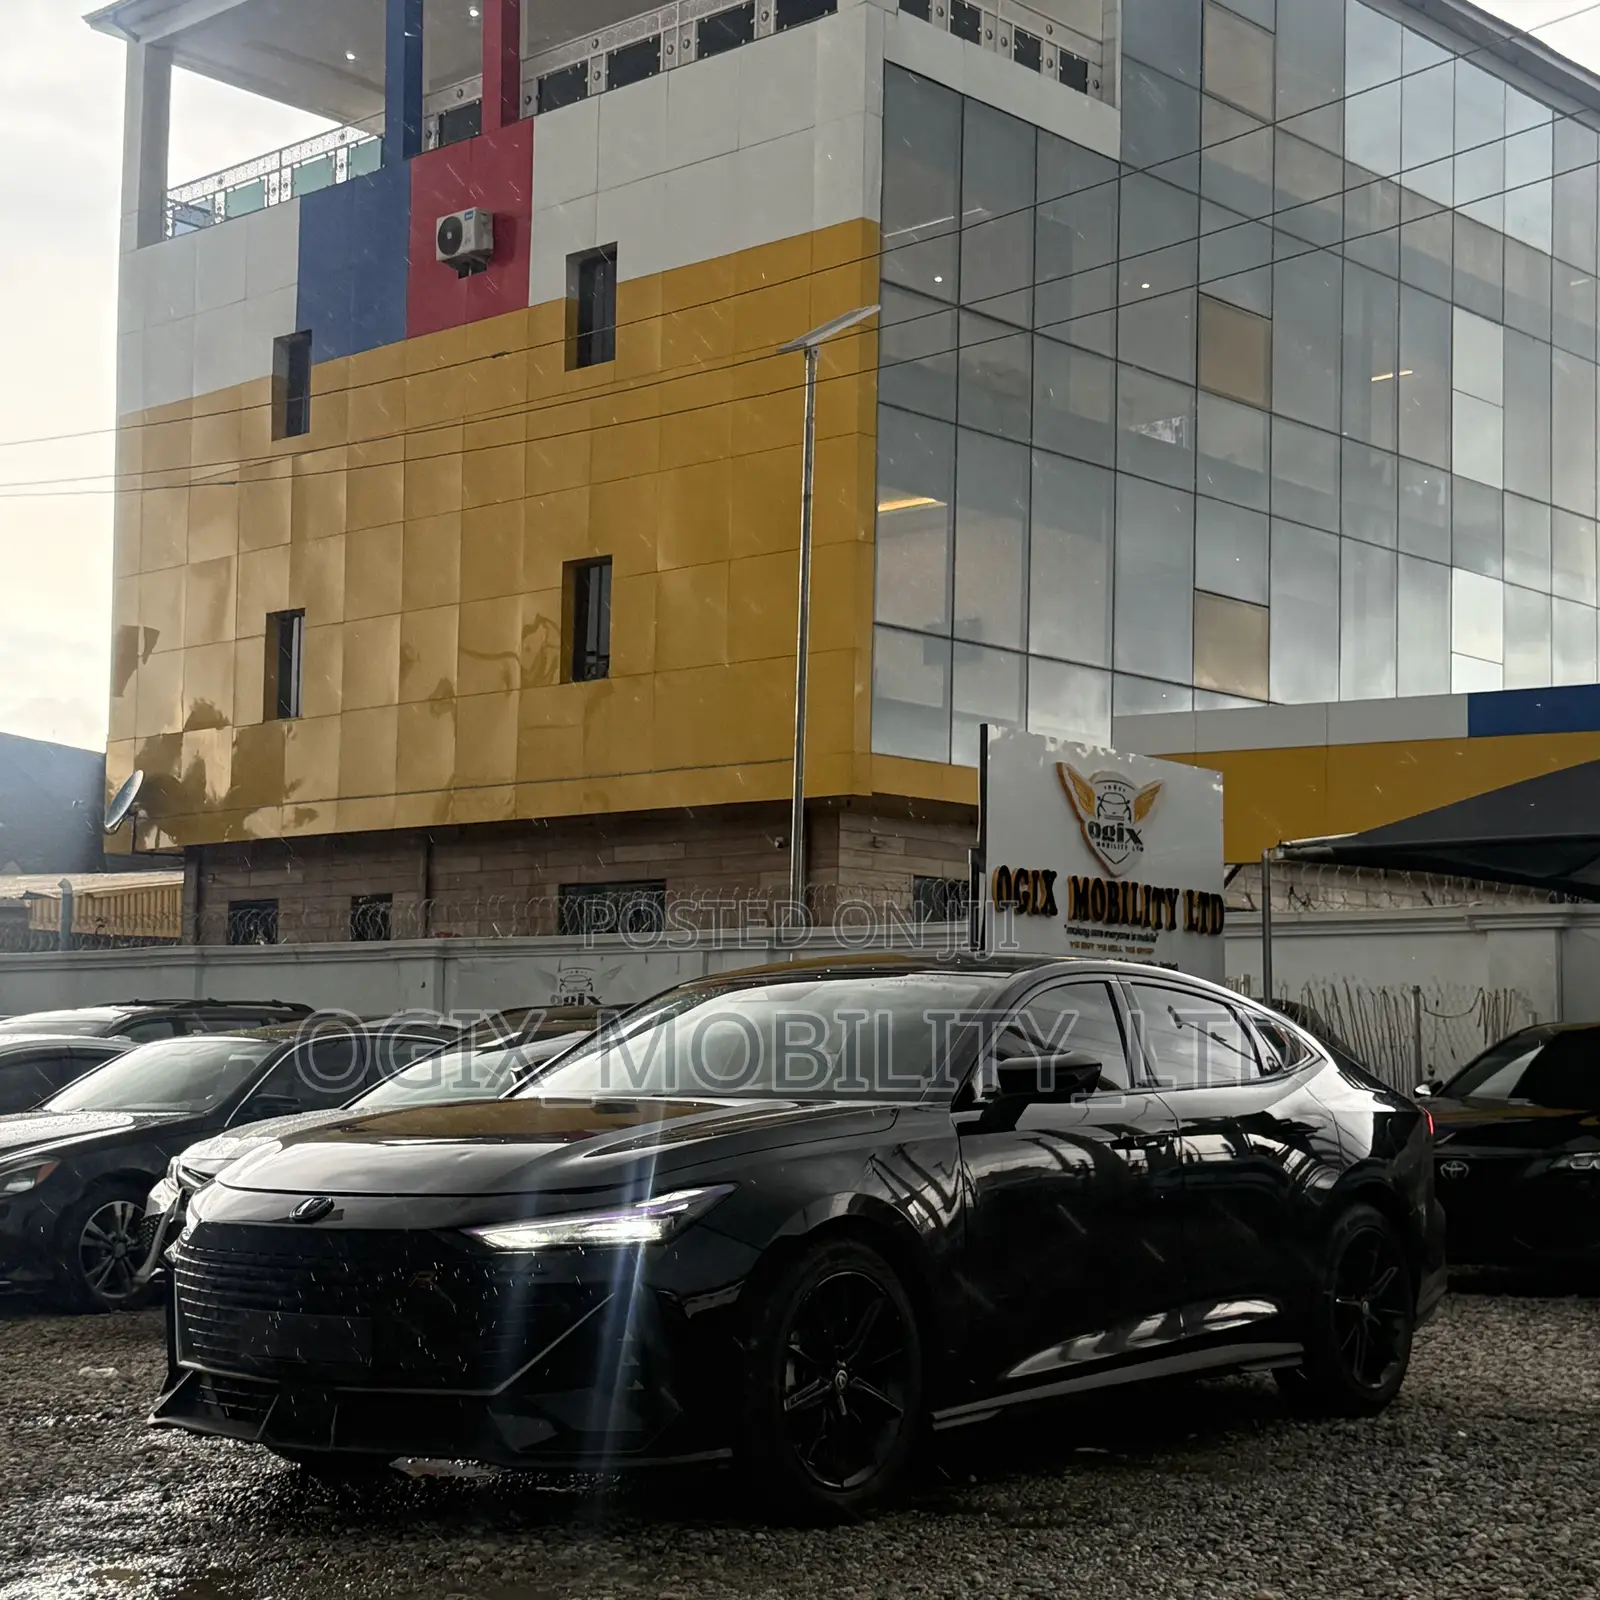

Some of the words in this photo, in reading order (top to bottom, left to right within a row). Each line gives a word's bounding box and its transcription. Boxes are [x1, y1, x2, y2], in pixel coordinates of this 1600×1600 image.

[1088, 821, 1143, 845] ogix
[1096, 841, 1128, 851] MOBILITY
[992, 865, 1058, 916] OGIX
[1067, 875, 1179, 931] MOBILITY
[1182, 889, 1224, 935] LTD
